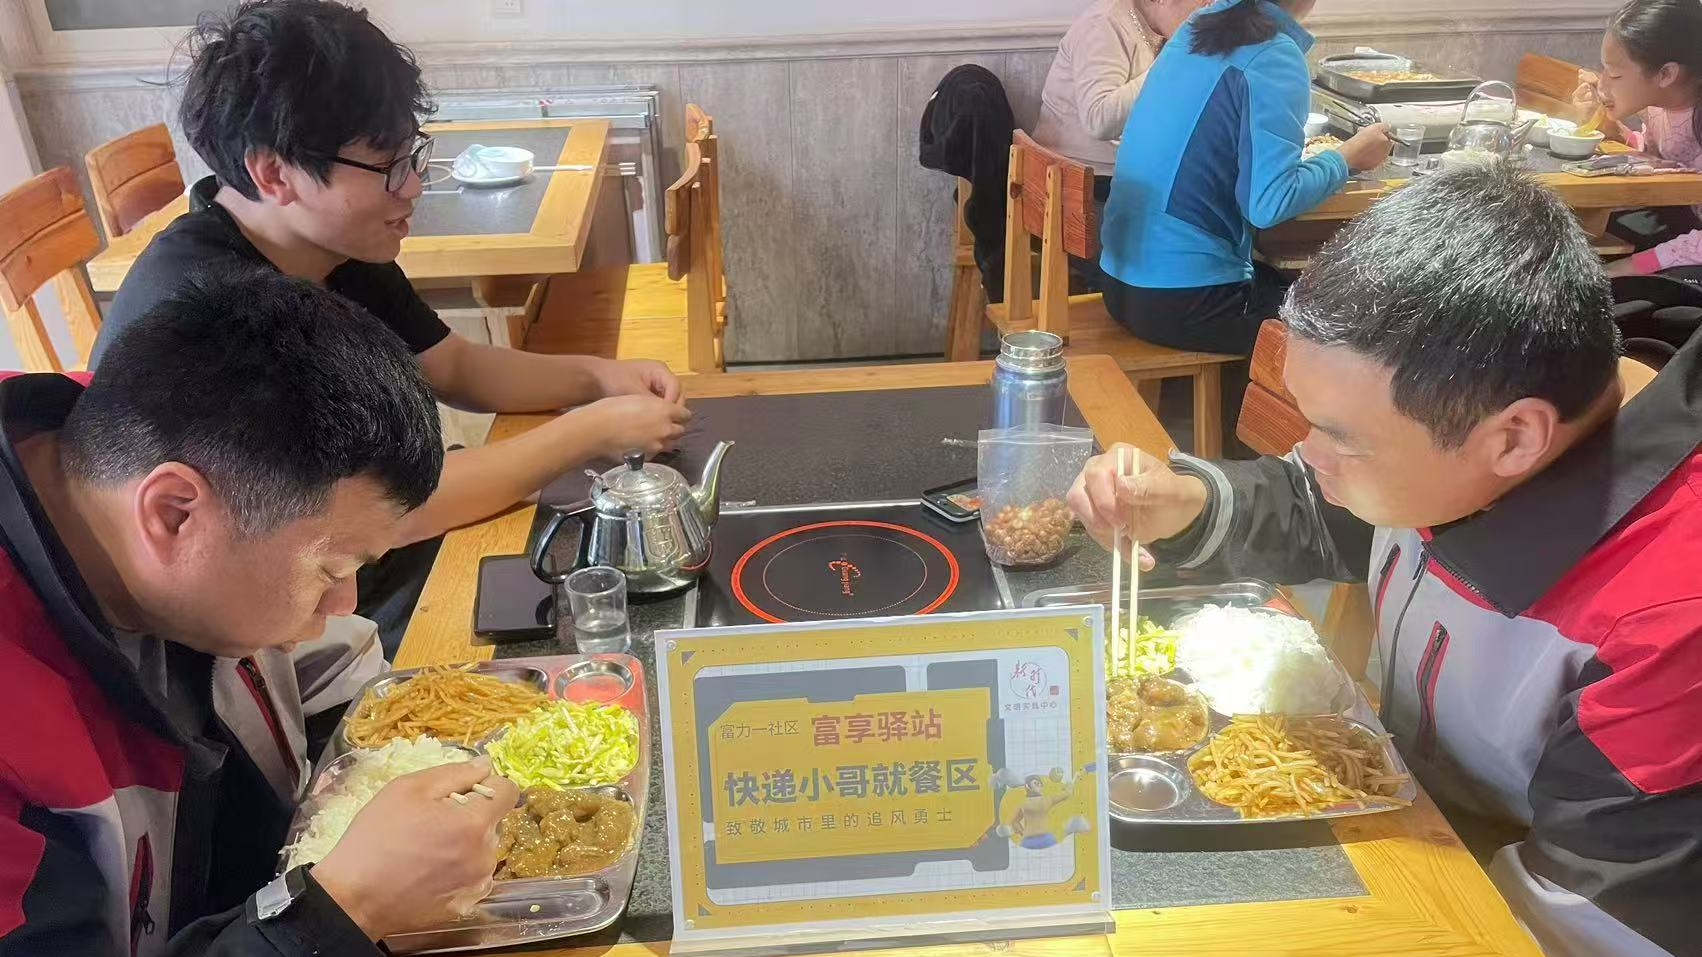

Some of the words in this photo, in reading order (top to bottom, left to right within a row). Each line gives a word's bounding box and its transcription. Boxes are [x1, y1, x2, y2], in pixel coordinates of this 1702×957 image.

[720, 720, 800, 740] 富力一社区
[811, 708, 942, 747] 富享驿站
[724, 758, 980, 807] 快递小哥就餐区
[725, 808, 953, 836] 致敬城市里的追风勇士
